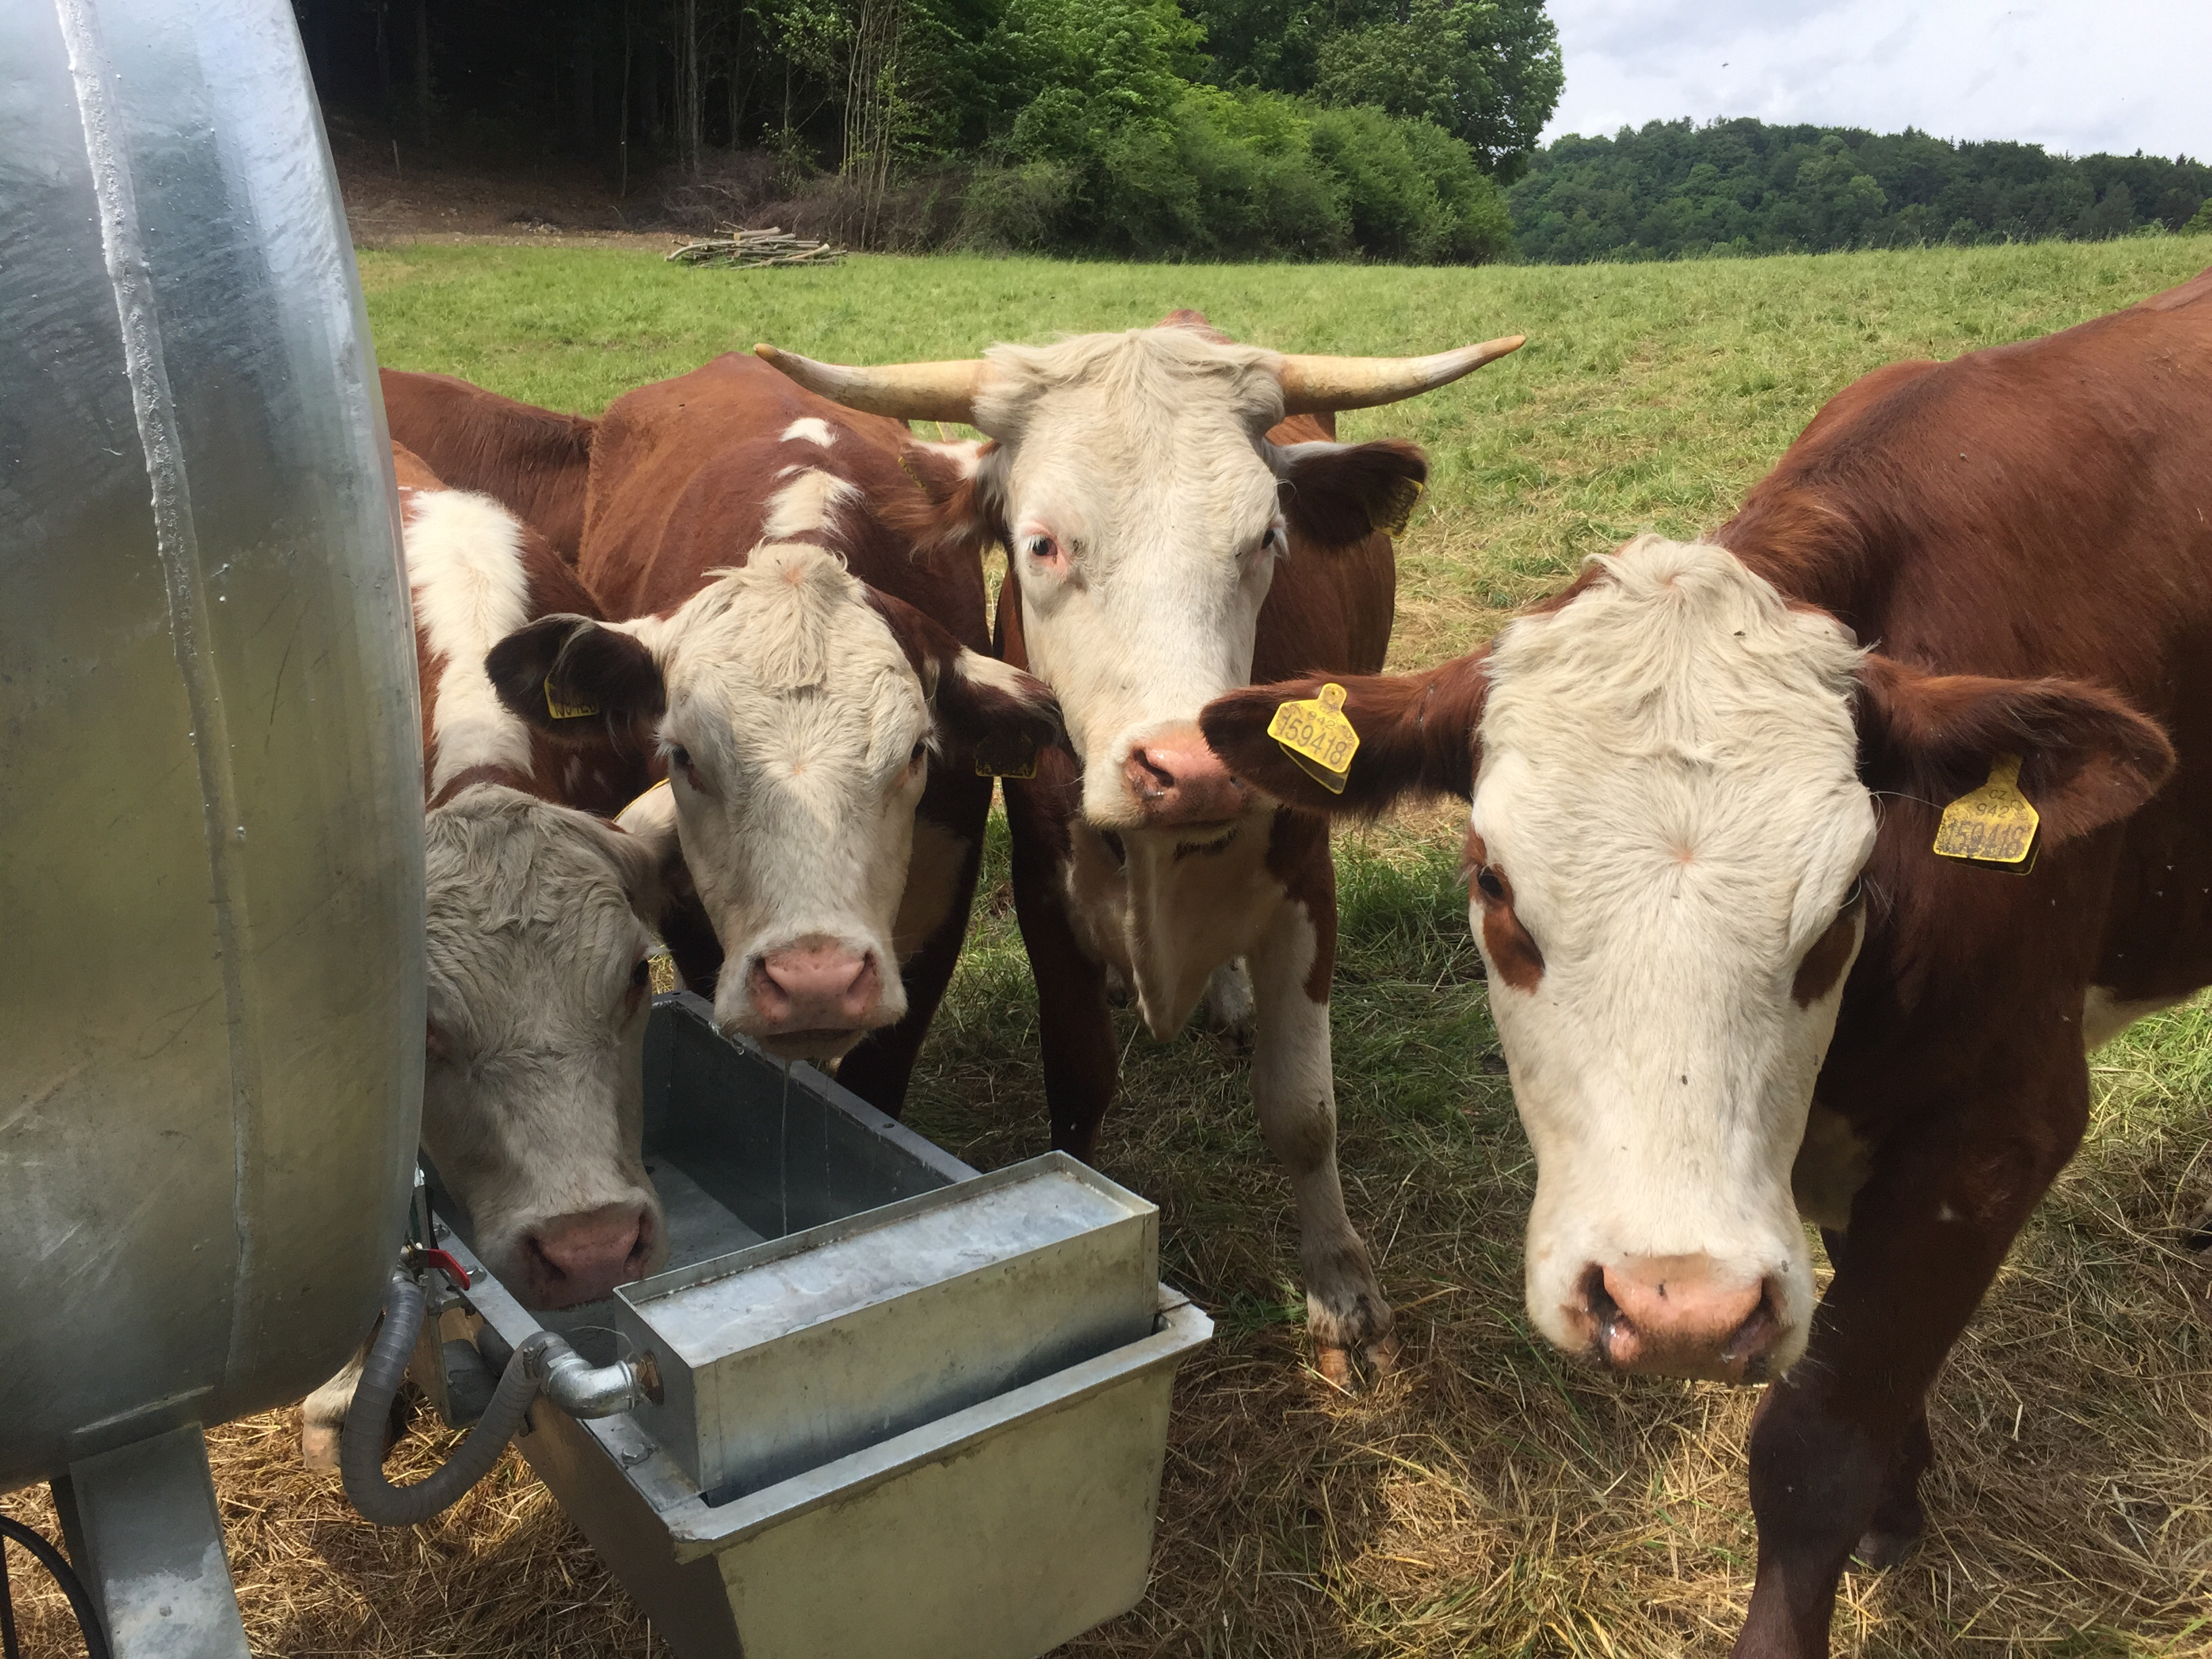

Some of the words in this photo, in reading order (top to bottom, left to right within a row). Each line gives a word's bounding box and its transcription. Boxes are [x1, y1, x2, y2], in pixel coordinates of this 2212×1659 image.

[1279, 714, 1347, 765] 159418
[1989, 789, 2007, 800] CZ
[1976, 803, 2010, 819] 942
